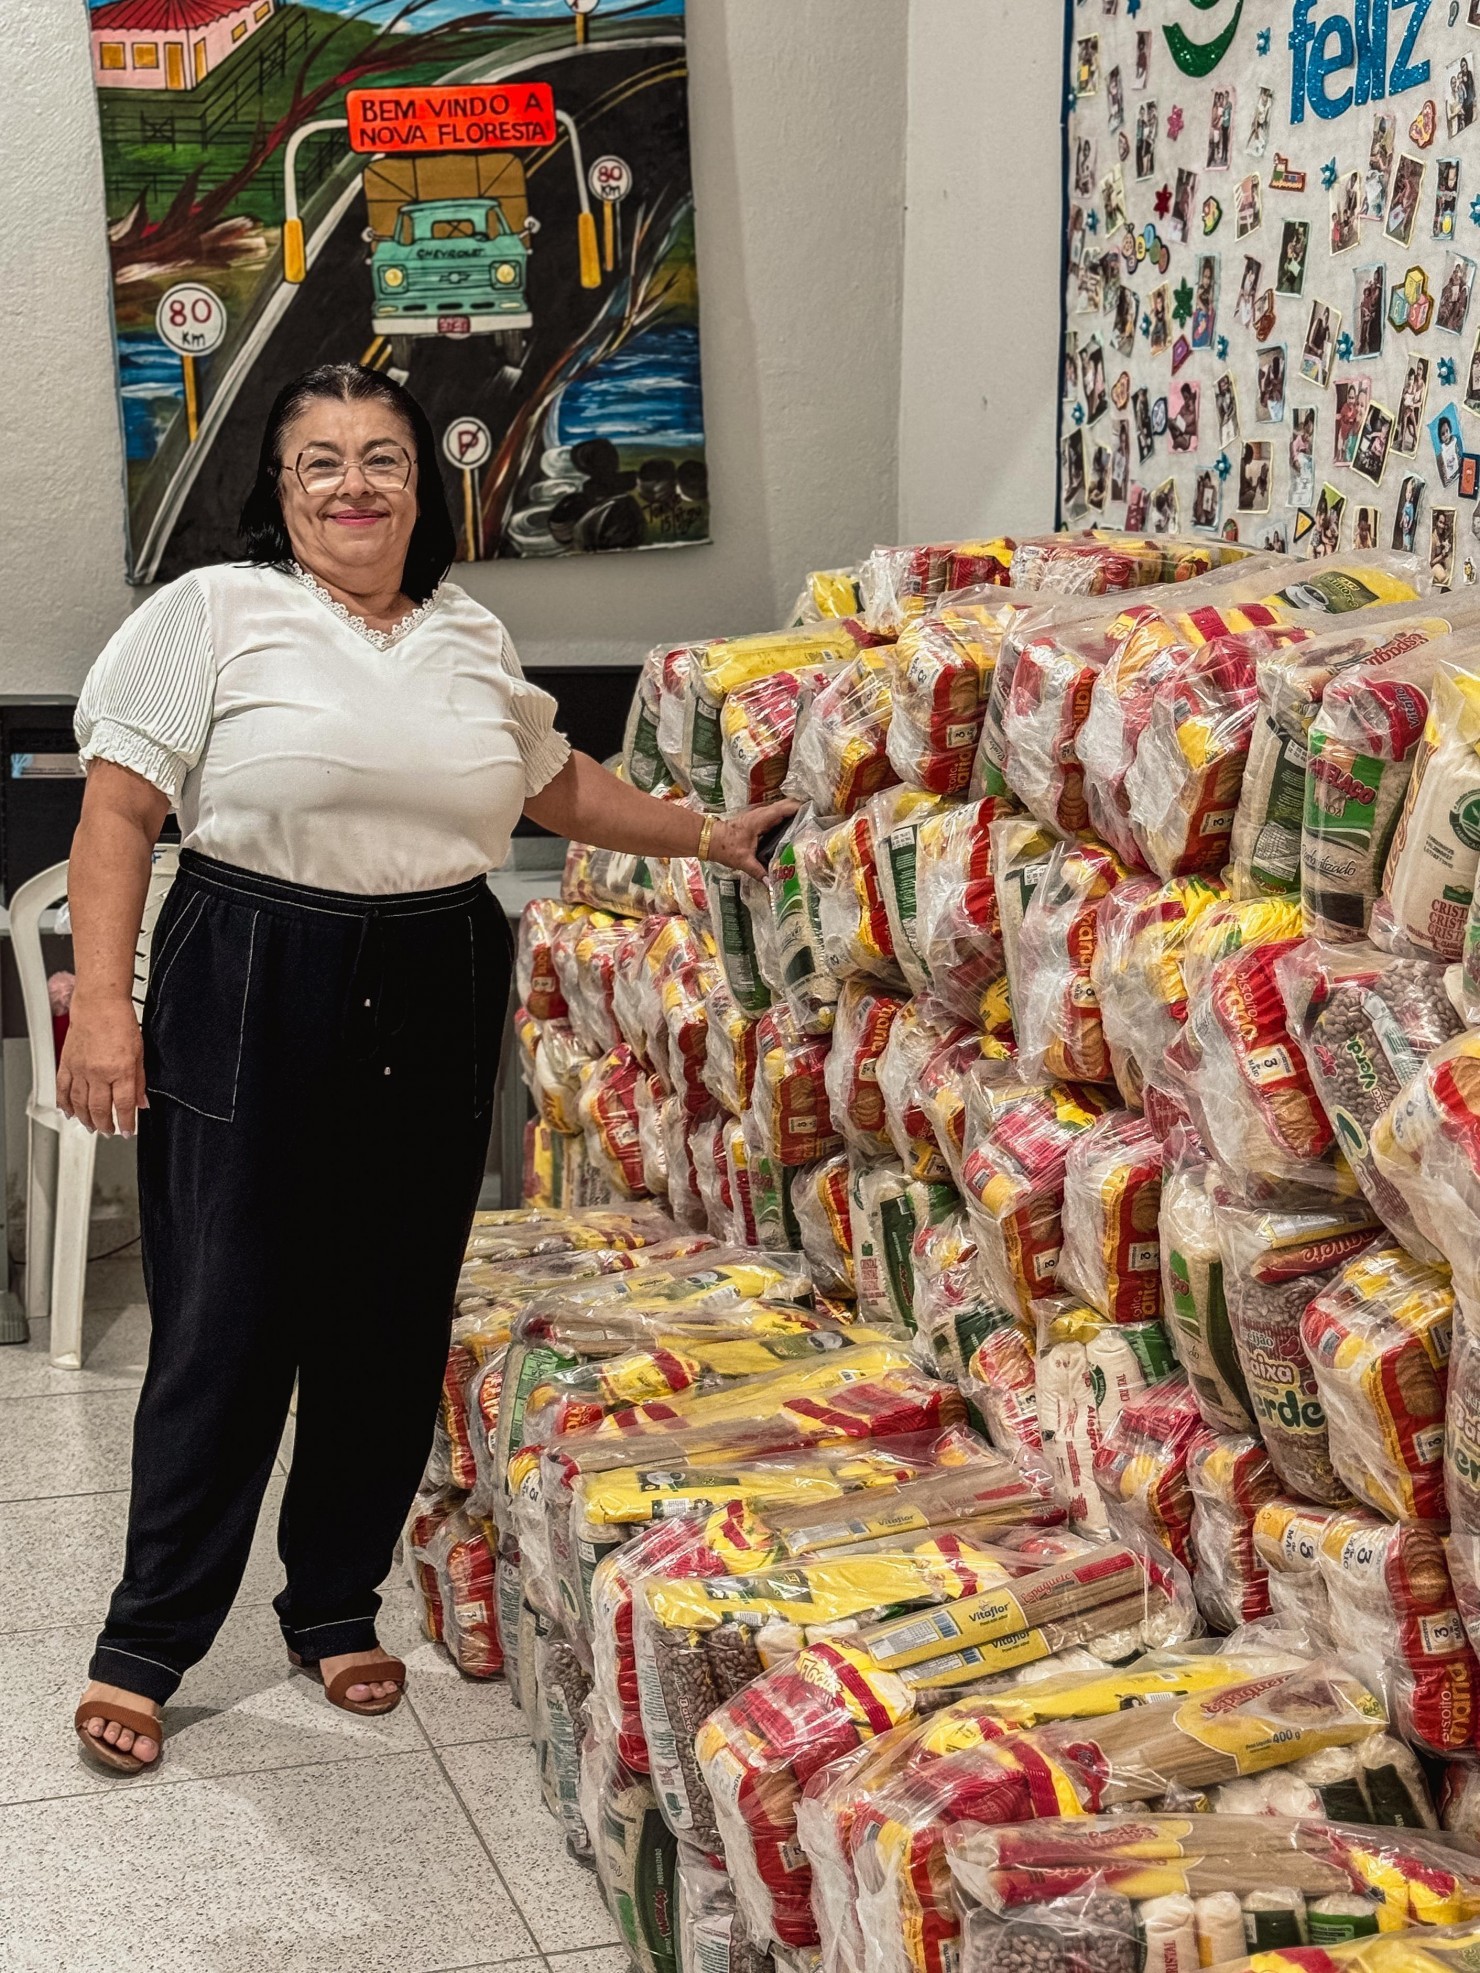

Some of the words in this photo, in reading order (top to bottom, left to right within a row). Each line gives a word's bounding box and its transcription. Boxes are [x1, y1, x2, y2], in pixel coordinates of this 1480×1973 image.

[1288, 0, 1430, 125] feliz
[361, 99, 417, 123] BEM
[425, 93, 509, 118] VINDO
[523, 92, 543, 113] A
[359, 124, 427, 147] NOVA
[438, 120, 548, 145] FLORESTA
[597, 165, 623, 183] 80
[416, 247, 485, 260] CHEVROLET
[169, 298, 212, 327] 80
[457, 430, 479, 456] P
[1431, 899, 1469, 920] CRIST
[1429, 911, 1466, 930] CRIST
[1263, 1059, 1278, 1068] 3
[1247, 1329, 1275, 1349] eijão
[1249, 1354, 1295, 1385] aixa
[1025, 1394, 1036, 1404] 3
[1254, 1389, 1327, 1430] erde
[1428, 1437, 1442, 1448] 3
[1285, 1529, 1294, 1561] MAIO
[1299, 1541, 1313, 1559] 3
[1357, 1547, 1373, 1564] 3
[968, 1601, 1011, 1624] Vitaflor
[1434, 1626, 1449, 1639] 3
[1272, 1729, 1294, 1744] 400
